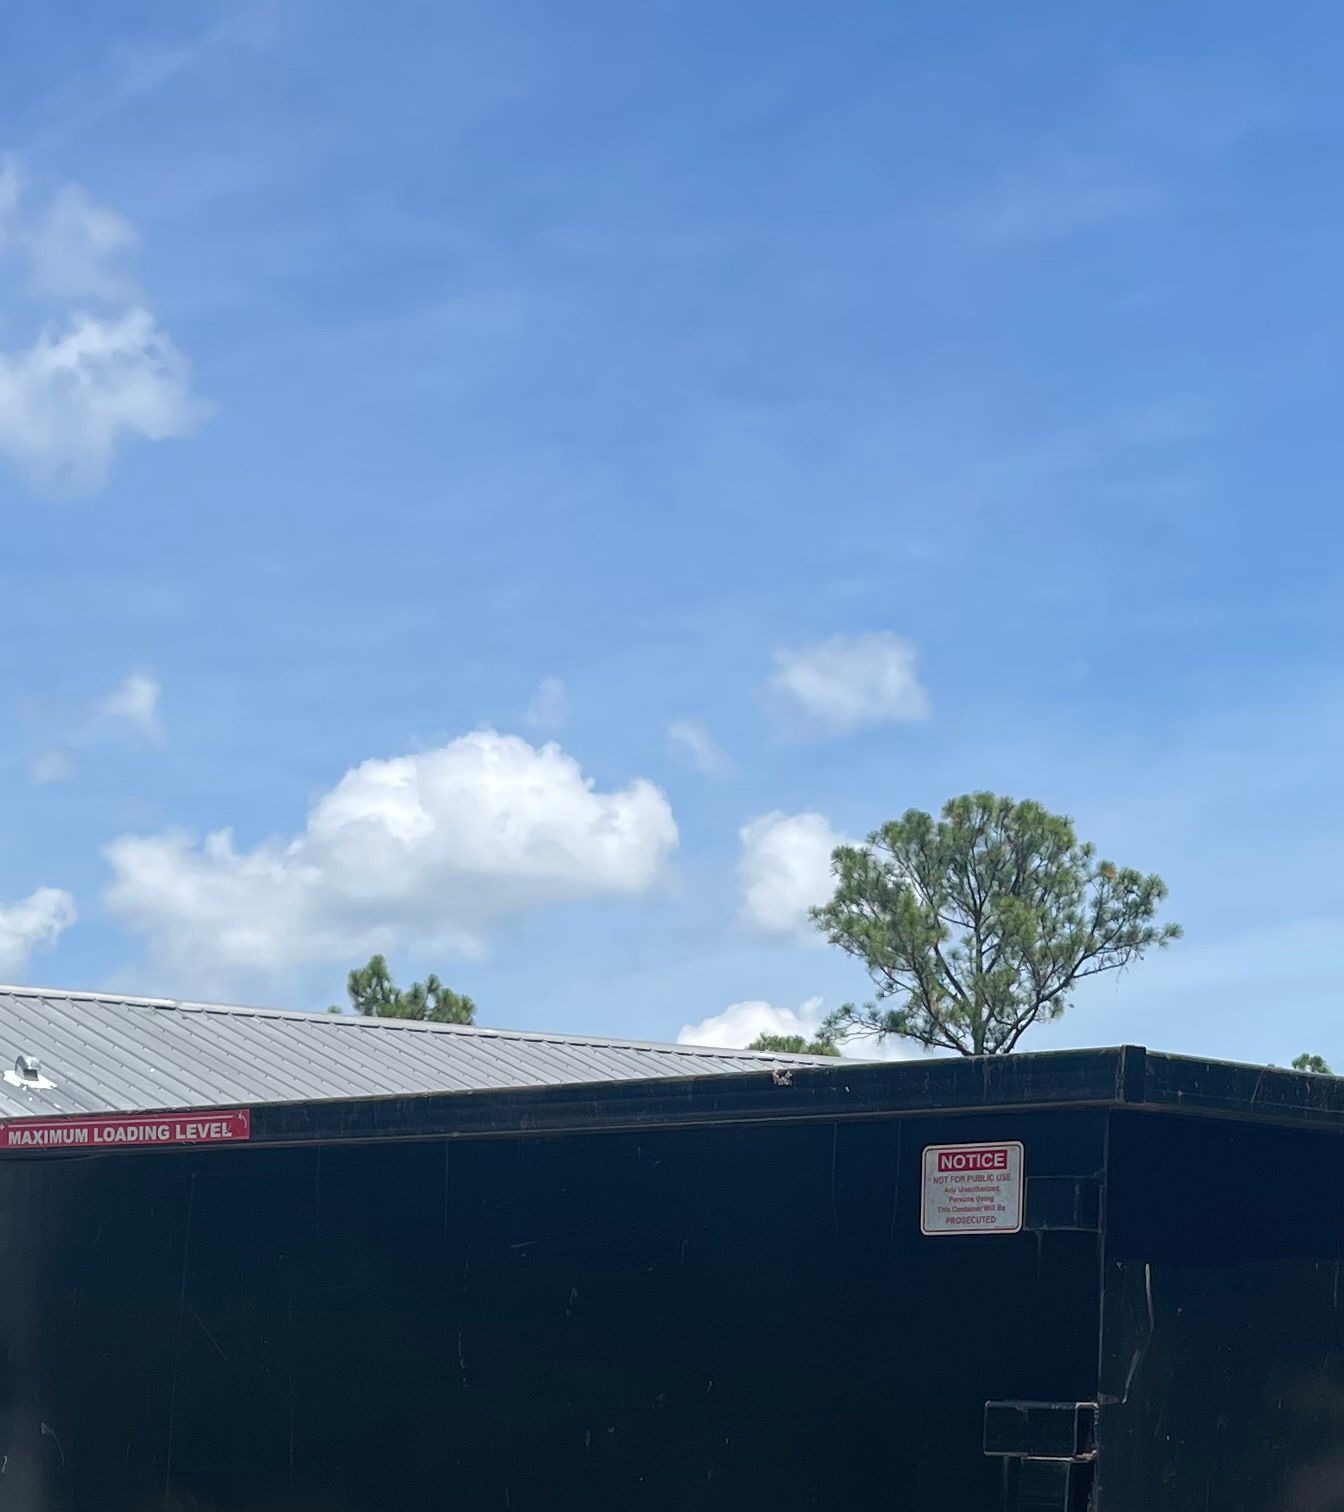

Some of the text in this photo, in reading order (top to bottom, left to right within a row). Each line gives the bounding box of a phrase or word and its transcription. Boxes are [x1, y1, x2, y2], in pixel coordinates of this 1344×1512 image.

[8, 1122, 232, 1145] MAXIMUM LOADING LEVEL
[941, 1153, 1005, 1169] NOTICE
[933, 1173, 1012, 1185] NOT FOR PUBLIC USE
[946, 1215, 997, 1225] PROSECUTED
